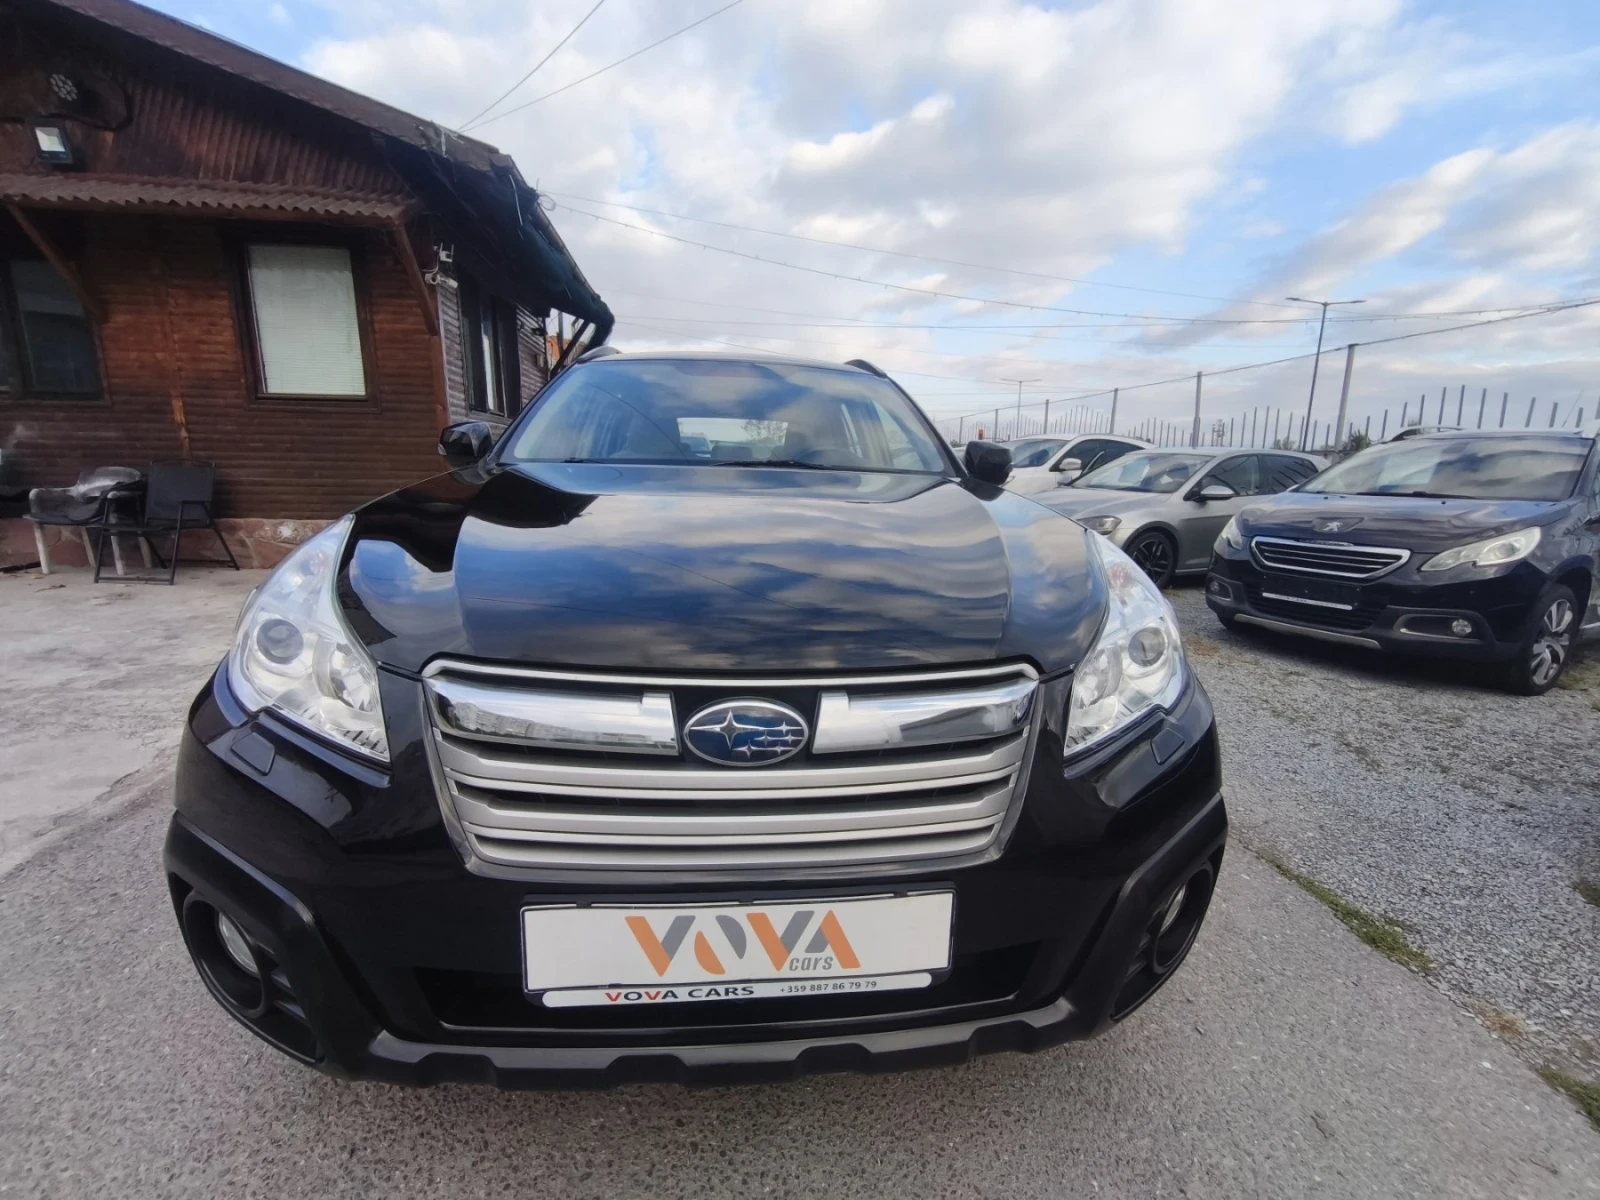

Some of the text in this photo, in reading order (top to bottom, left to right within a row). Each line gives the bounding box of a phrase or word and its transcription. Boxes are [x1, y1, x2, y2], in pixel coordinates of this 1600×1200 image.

[625, 910, 861, 977] VOVA
[789, 956, 833, 971] cars
[605, 980, 877, 1002] VOVA CARS +359 887 86 79 79
